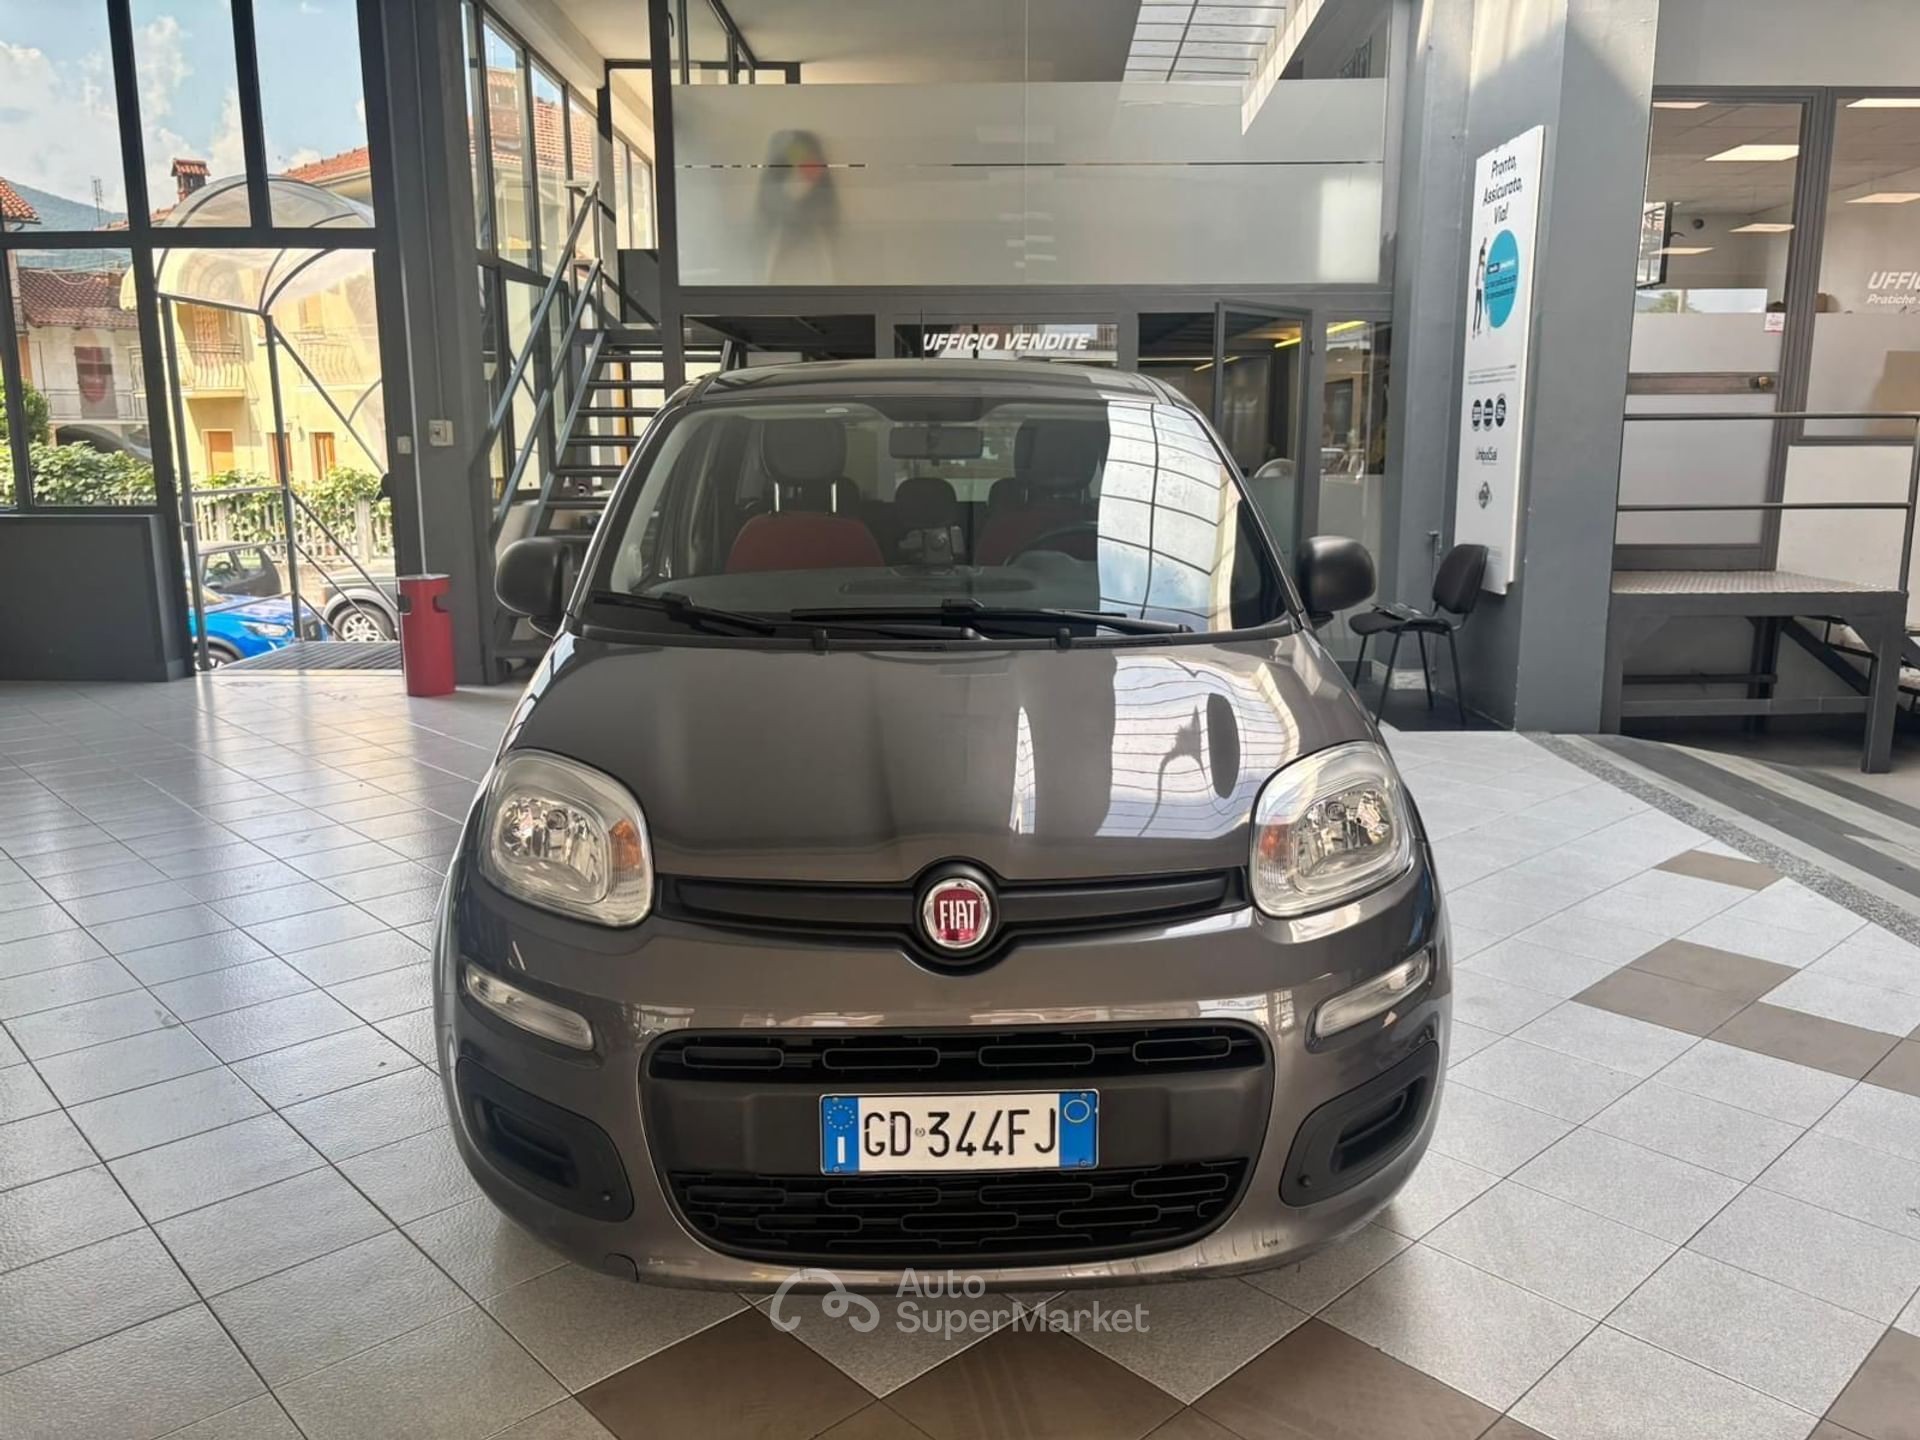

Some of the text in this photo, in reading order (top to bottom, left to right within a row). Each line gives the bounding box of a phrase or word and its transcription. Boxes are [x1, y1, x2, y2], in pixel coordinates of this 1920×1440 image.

[1866, 293, 1916, 305] Pratiche
[923, 333, 1090, 350] UFFICIO VENDITE
[939, 899, 978, 930] FIAT
